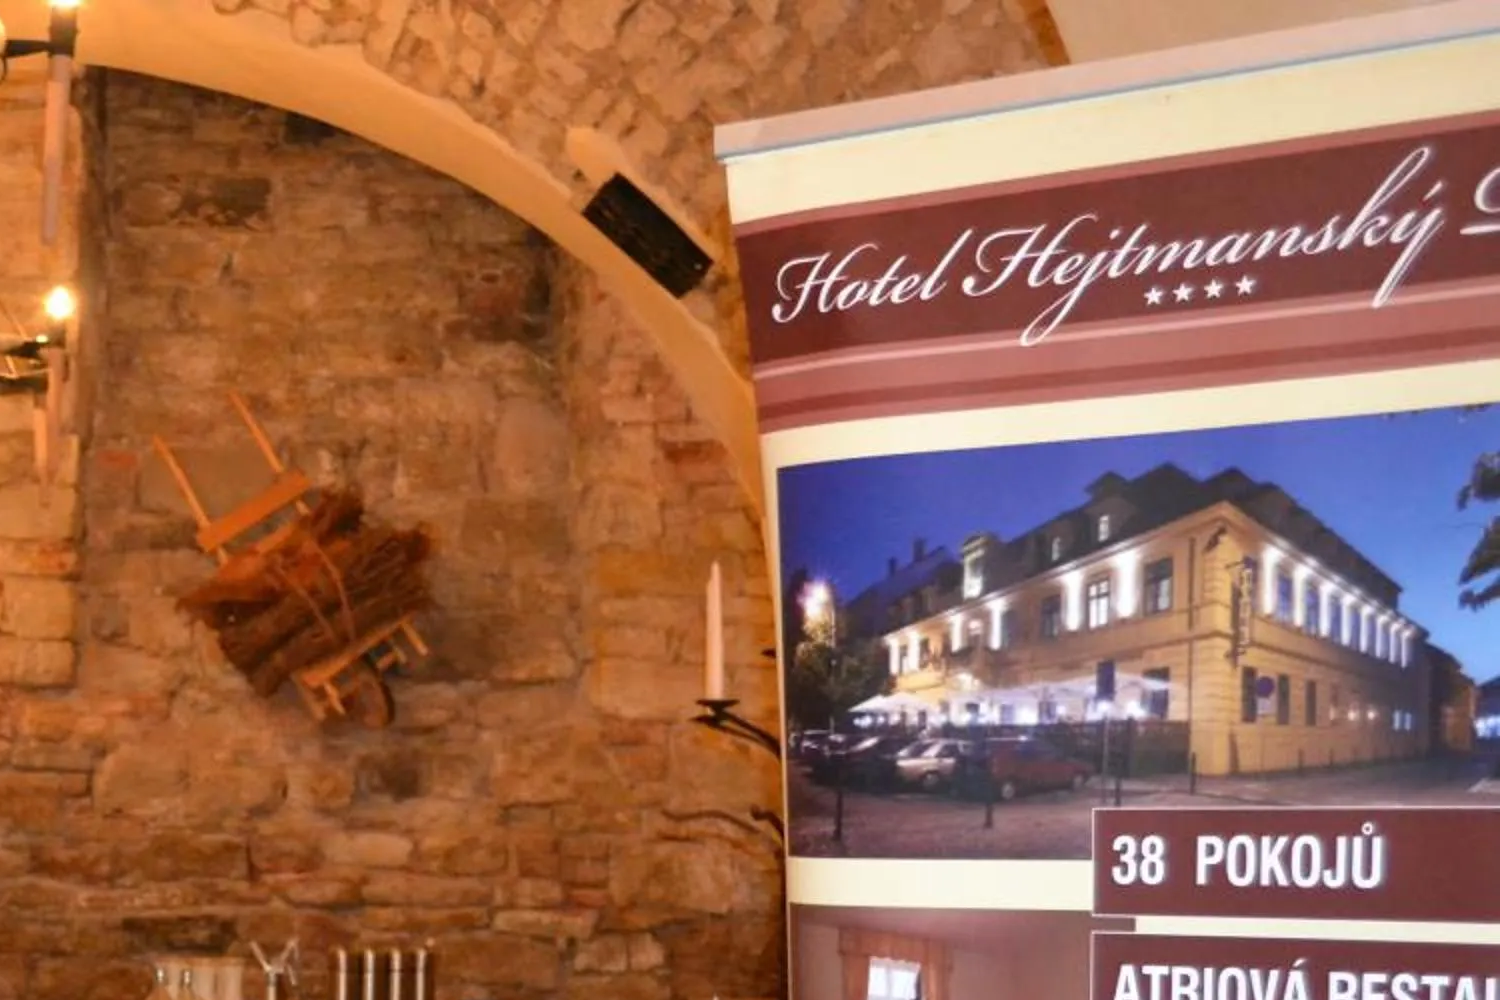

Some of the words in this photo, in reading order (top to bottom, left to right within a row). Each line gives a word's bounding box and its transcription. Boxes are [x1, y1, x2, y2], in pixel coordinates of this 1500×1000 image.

[771, 229, 970, 323] Hotel
[961, 146, 1446, 346] Hejtmanský
[1111, 834, 1166, 886] 38
[1196, 821, 1384, 889] POKOJŮ
